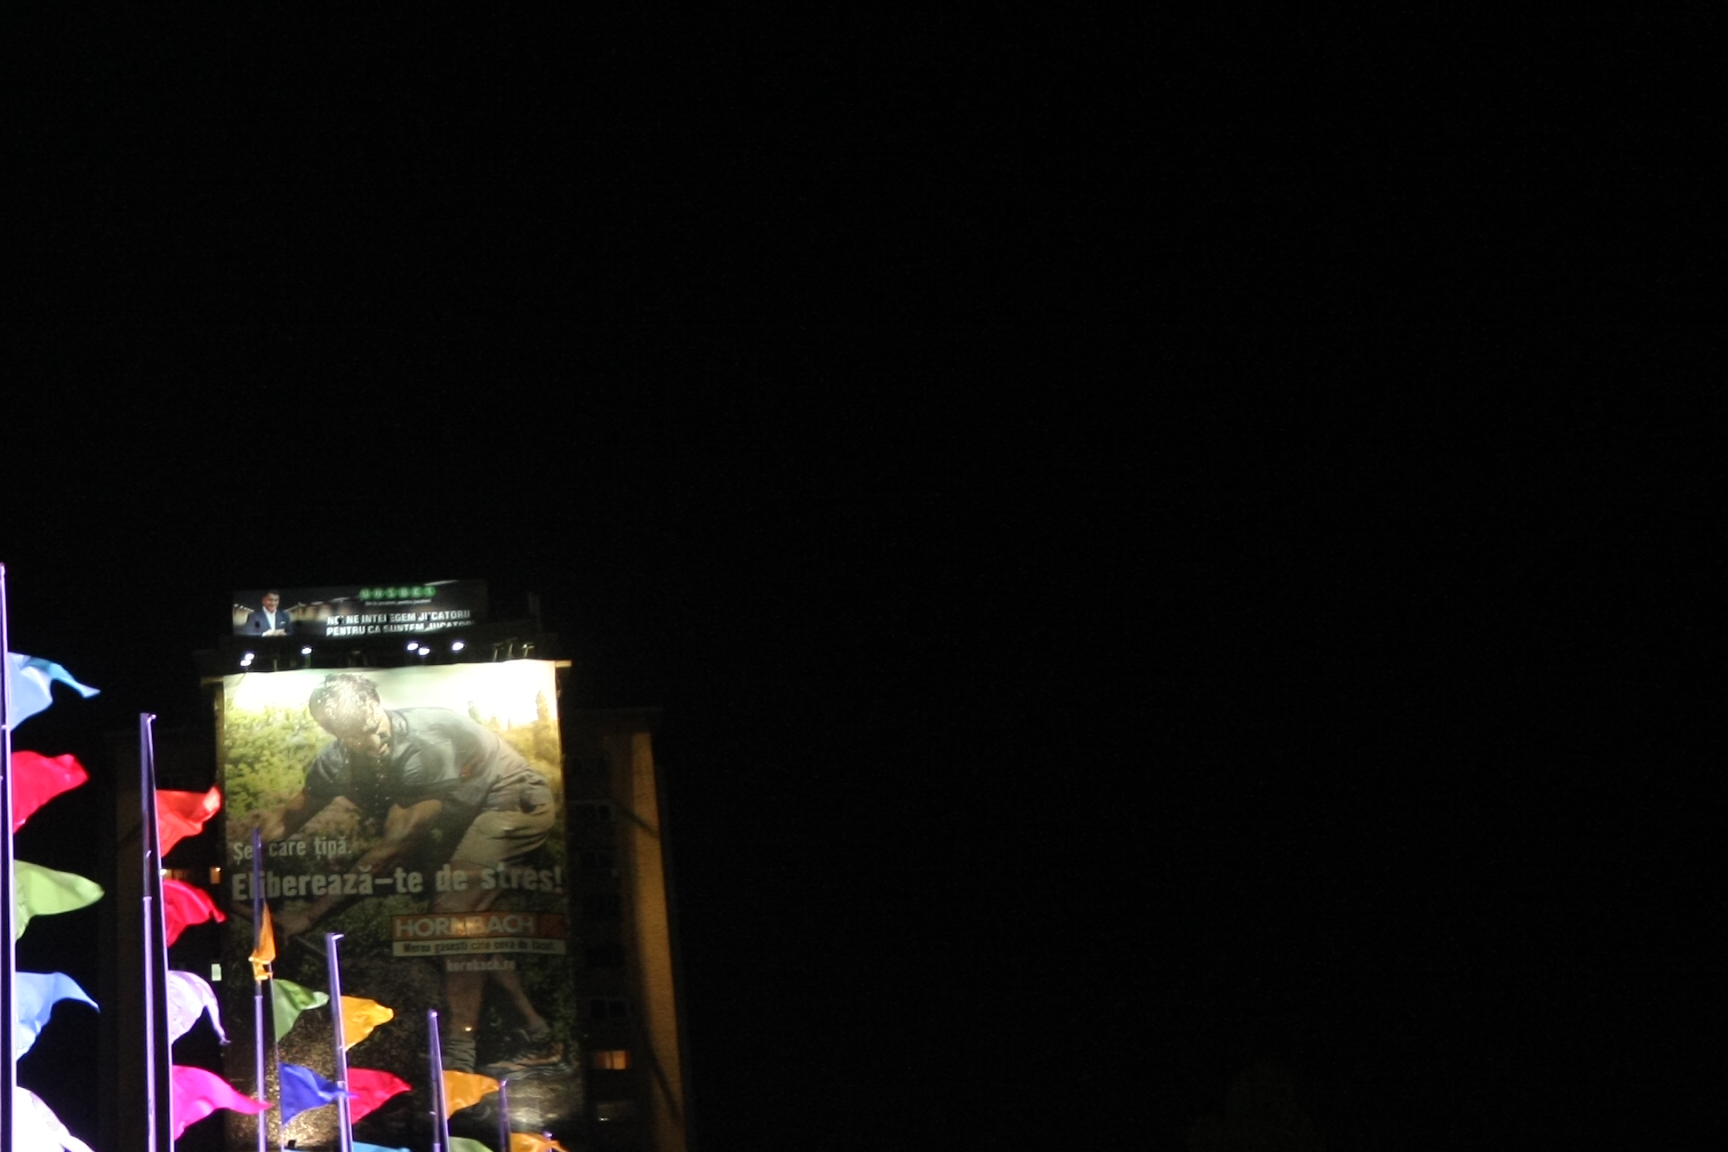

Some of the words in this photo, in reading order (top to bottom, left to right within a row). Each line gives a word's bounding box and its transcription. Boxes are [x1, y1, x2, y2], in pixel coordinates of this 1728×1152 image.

[346, 614, 359, 624] NE
[326, 625, 366, 636] PENTRU
[367, 624, 381, 634] CA
[269, 840, 307, 857] care
[436, 863, 466, 893] de
[480, 861, 565, 894] stres!
[395, 913, 535, 938] HORNBACH
